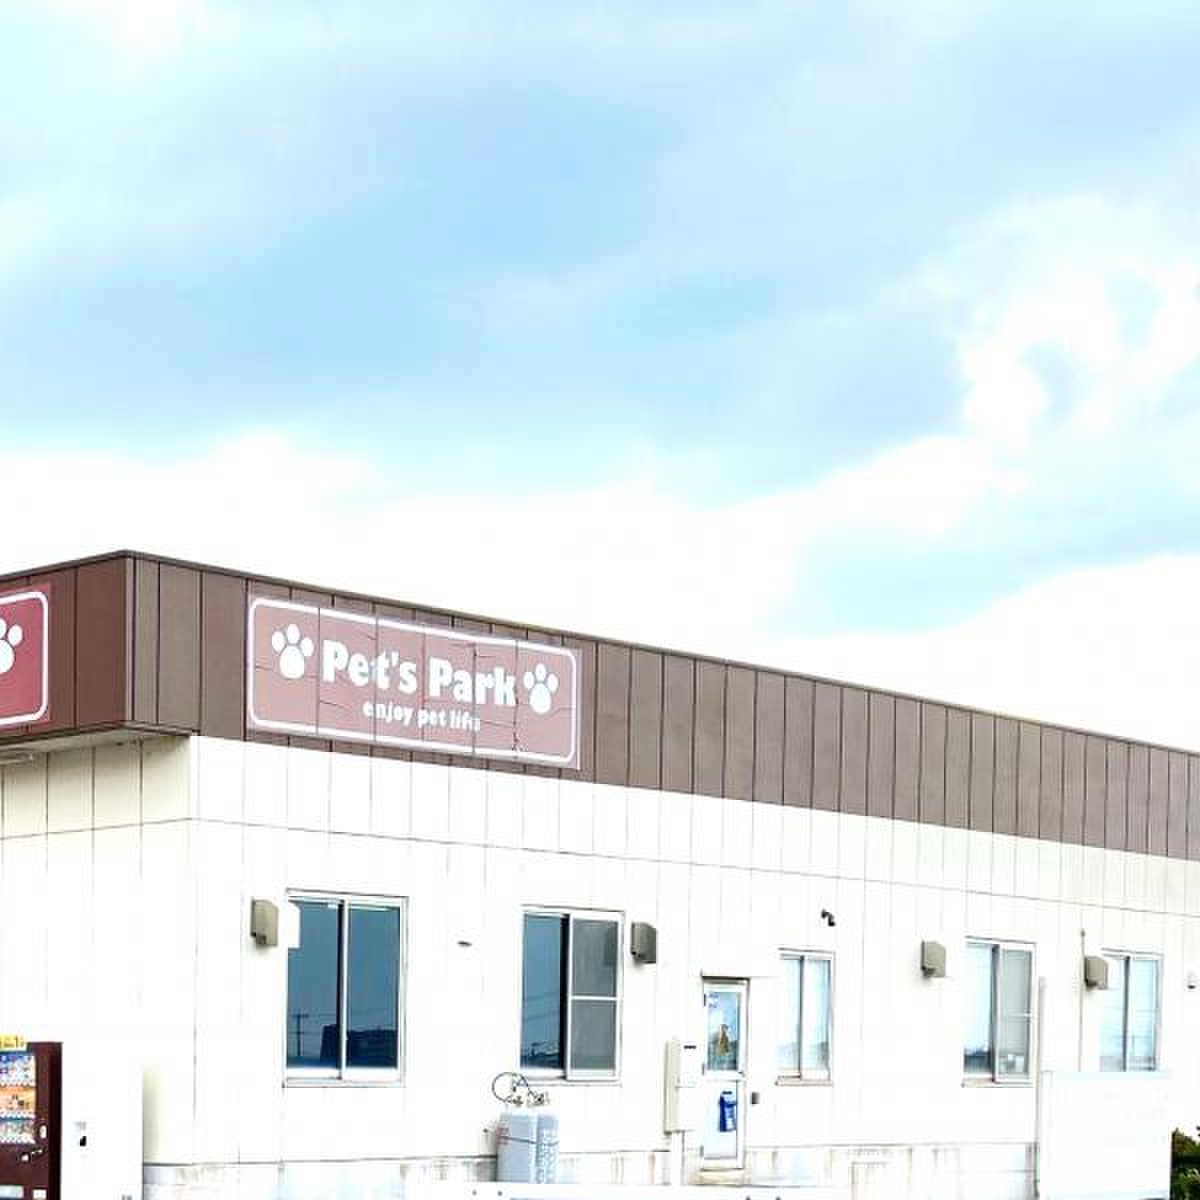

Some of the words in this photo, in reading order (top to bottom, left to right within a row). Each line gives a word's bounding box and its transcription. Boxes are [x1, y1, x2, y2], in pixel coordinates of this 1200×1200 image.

[322, 639, 418, 695] Pet's
[428, 656, 518, 707] Park
[362, 699, 414, 726] enjoy
[417, 706, 447, 729] pet
[450, 713, 481, 732] life
